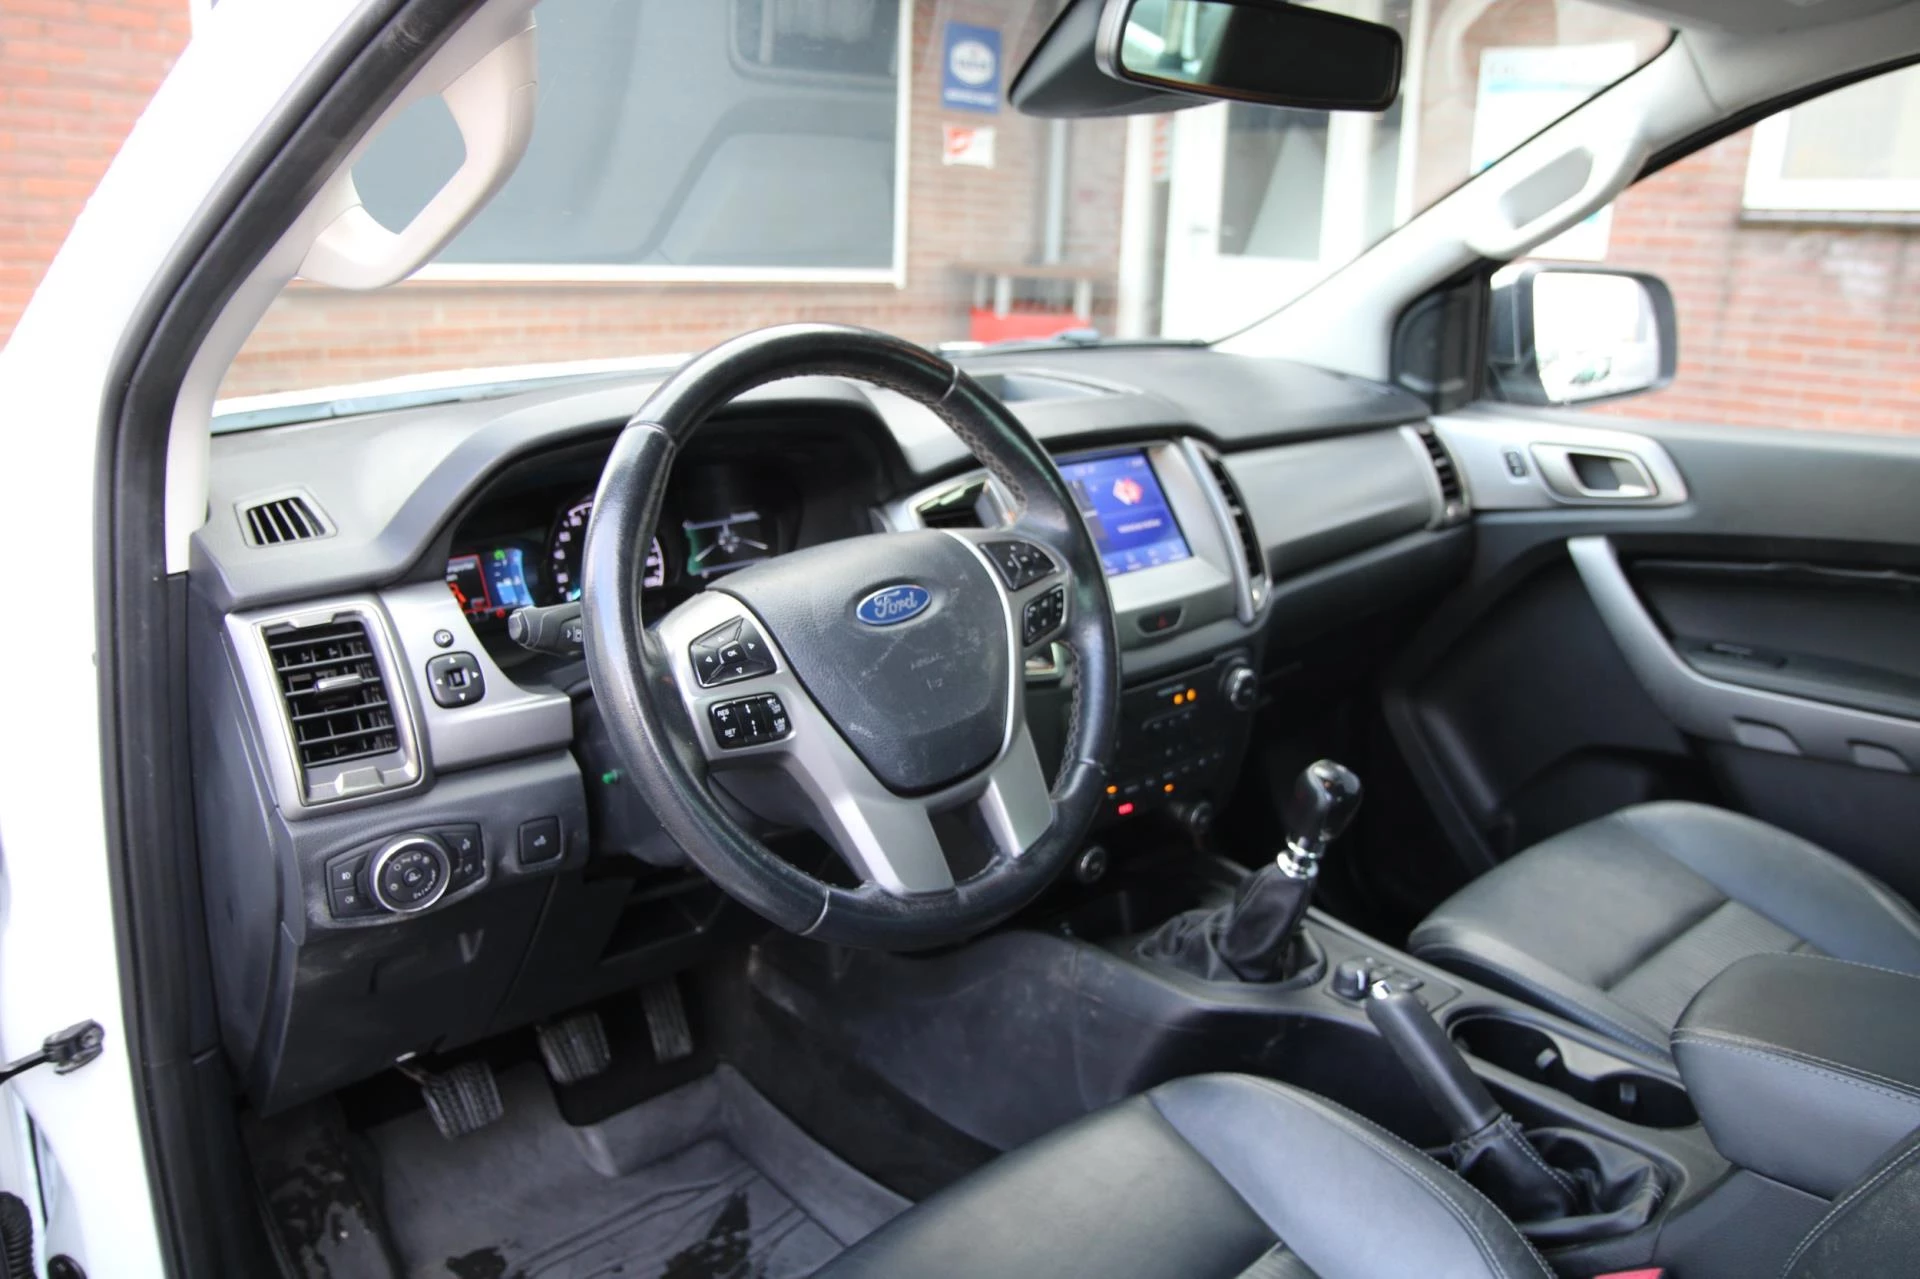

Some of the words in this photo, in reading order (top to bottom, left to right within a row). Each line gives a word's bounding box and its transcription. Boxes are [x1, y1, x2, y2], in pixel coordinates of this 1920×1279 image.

[873, 590, 918, 618] Ford
[727, 648, 738, 657] OK
[717, 708, 730, 717] RES
